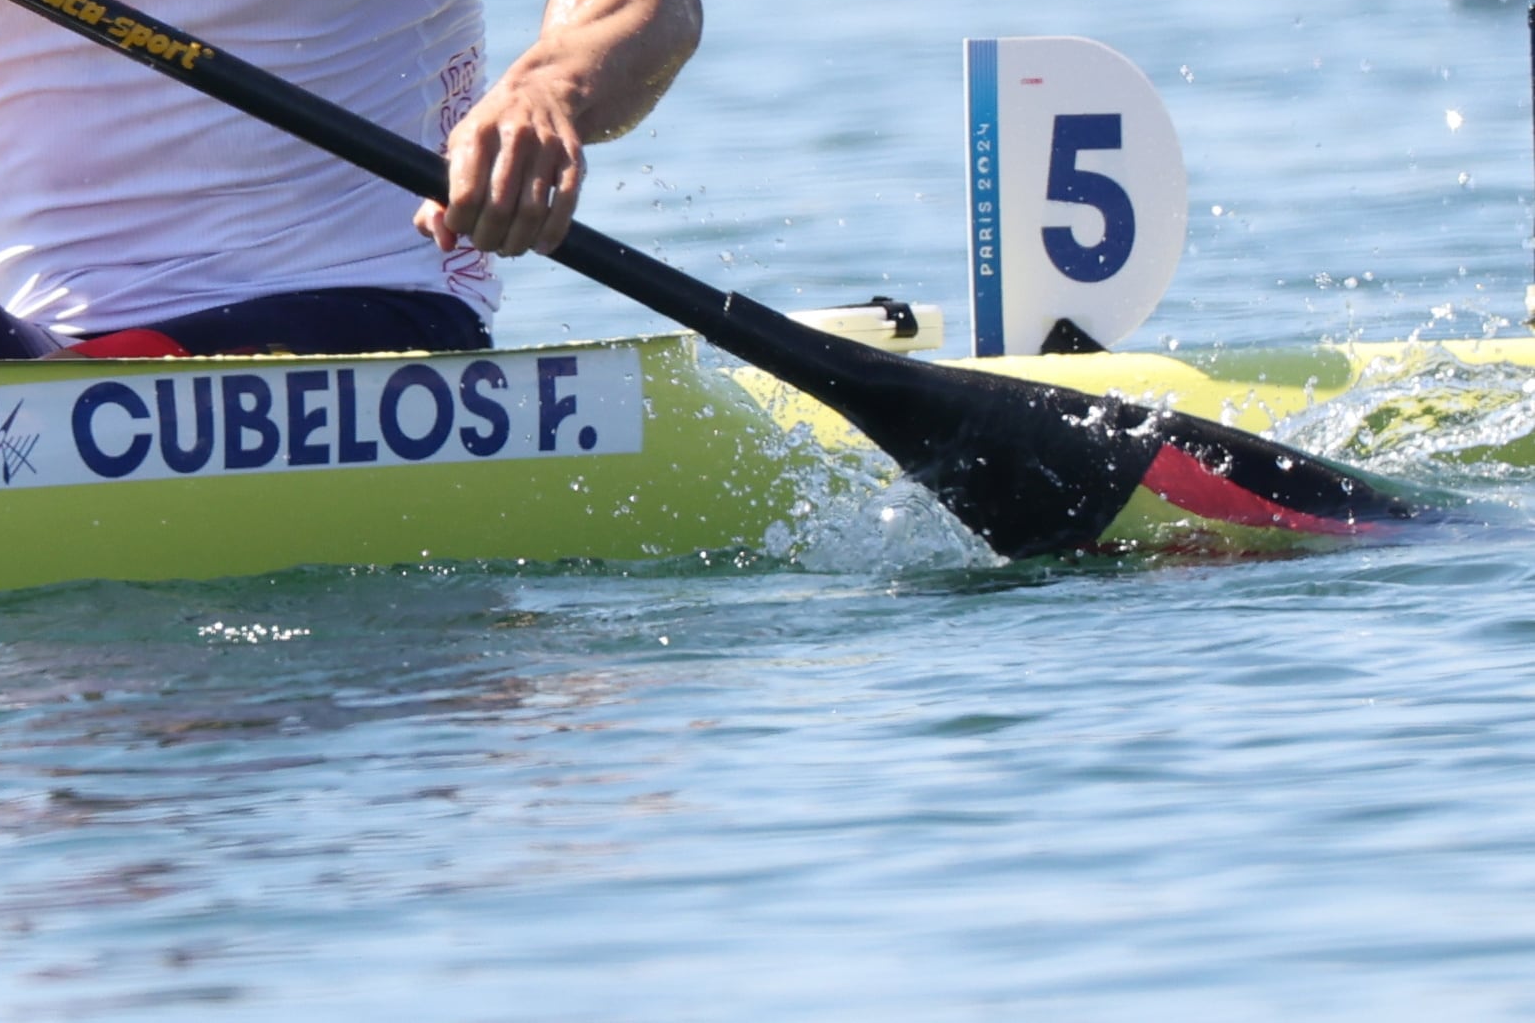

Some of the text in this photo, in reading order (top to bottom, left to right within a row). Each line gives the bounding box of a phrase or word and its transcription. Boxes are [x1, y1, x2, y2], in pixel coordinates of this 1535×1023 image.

[977, 123, 995, 276] PARIS 2024
[1041, 113, 1136, 283] 5
[72, 356, 597, 478] CUBELOS F.
